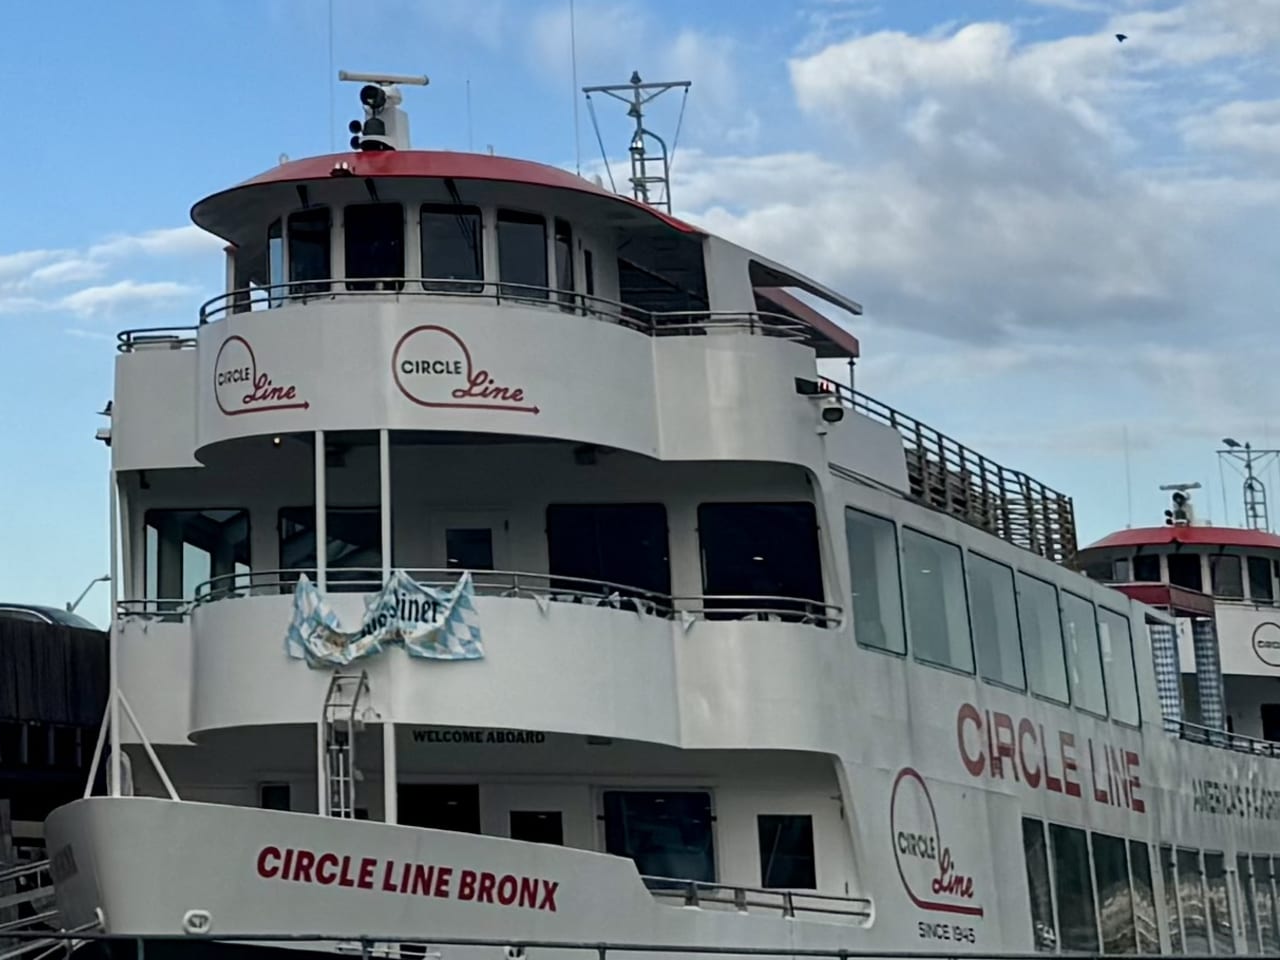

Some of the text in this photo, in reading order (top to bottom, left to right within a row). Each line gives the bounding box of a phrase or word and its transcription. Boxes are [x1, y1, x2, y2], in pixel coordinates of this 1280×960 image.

[217, 366, 251, 387] CIRCLE
[400, 359, 463, 376] CIRCLE
[242, 373, 297, 404] Line
[451, 369, 525, 402] Line
[412, 729, 546, 745] WELCOME ABOARD
[957, 702, 1146, 815] CIRCLE LINE
[897, 831, 936, 860] CIRCLE
[256, 845, 560, 912] CIRCLE LINE BRONX
[931, 847, 974, 898] Line
[918, 921, 951, 940] SINCE
